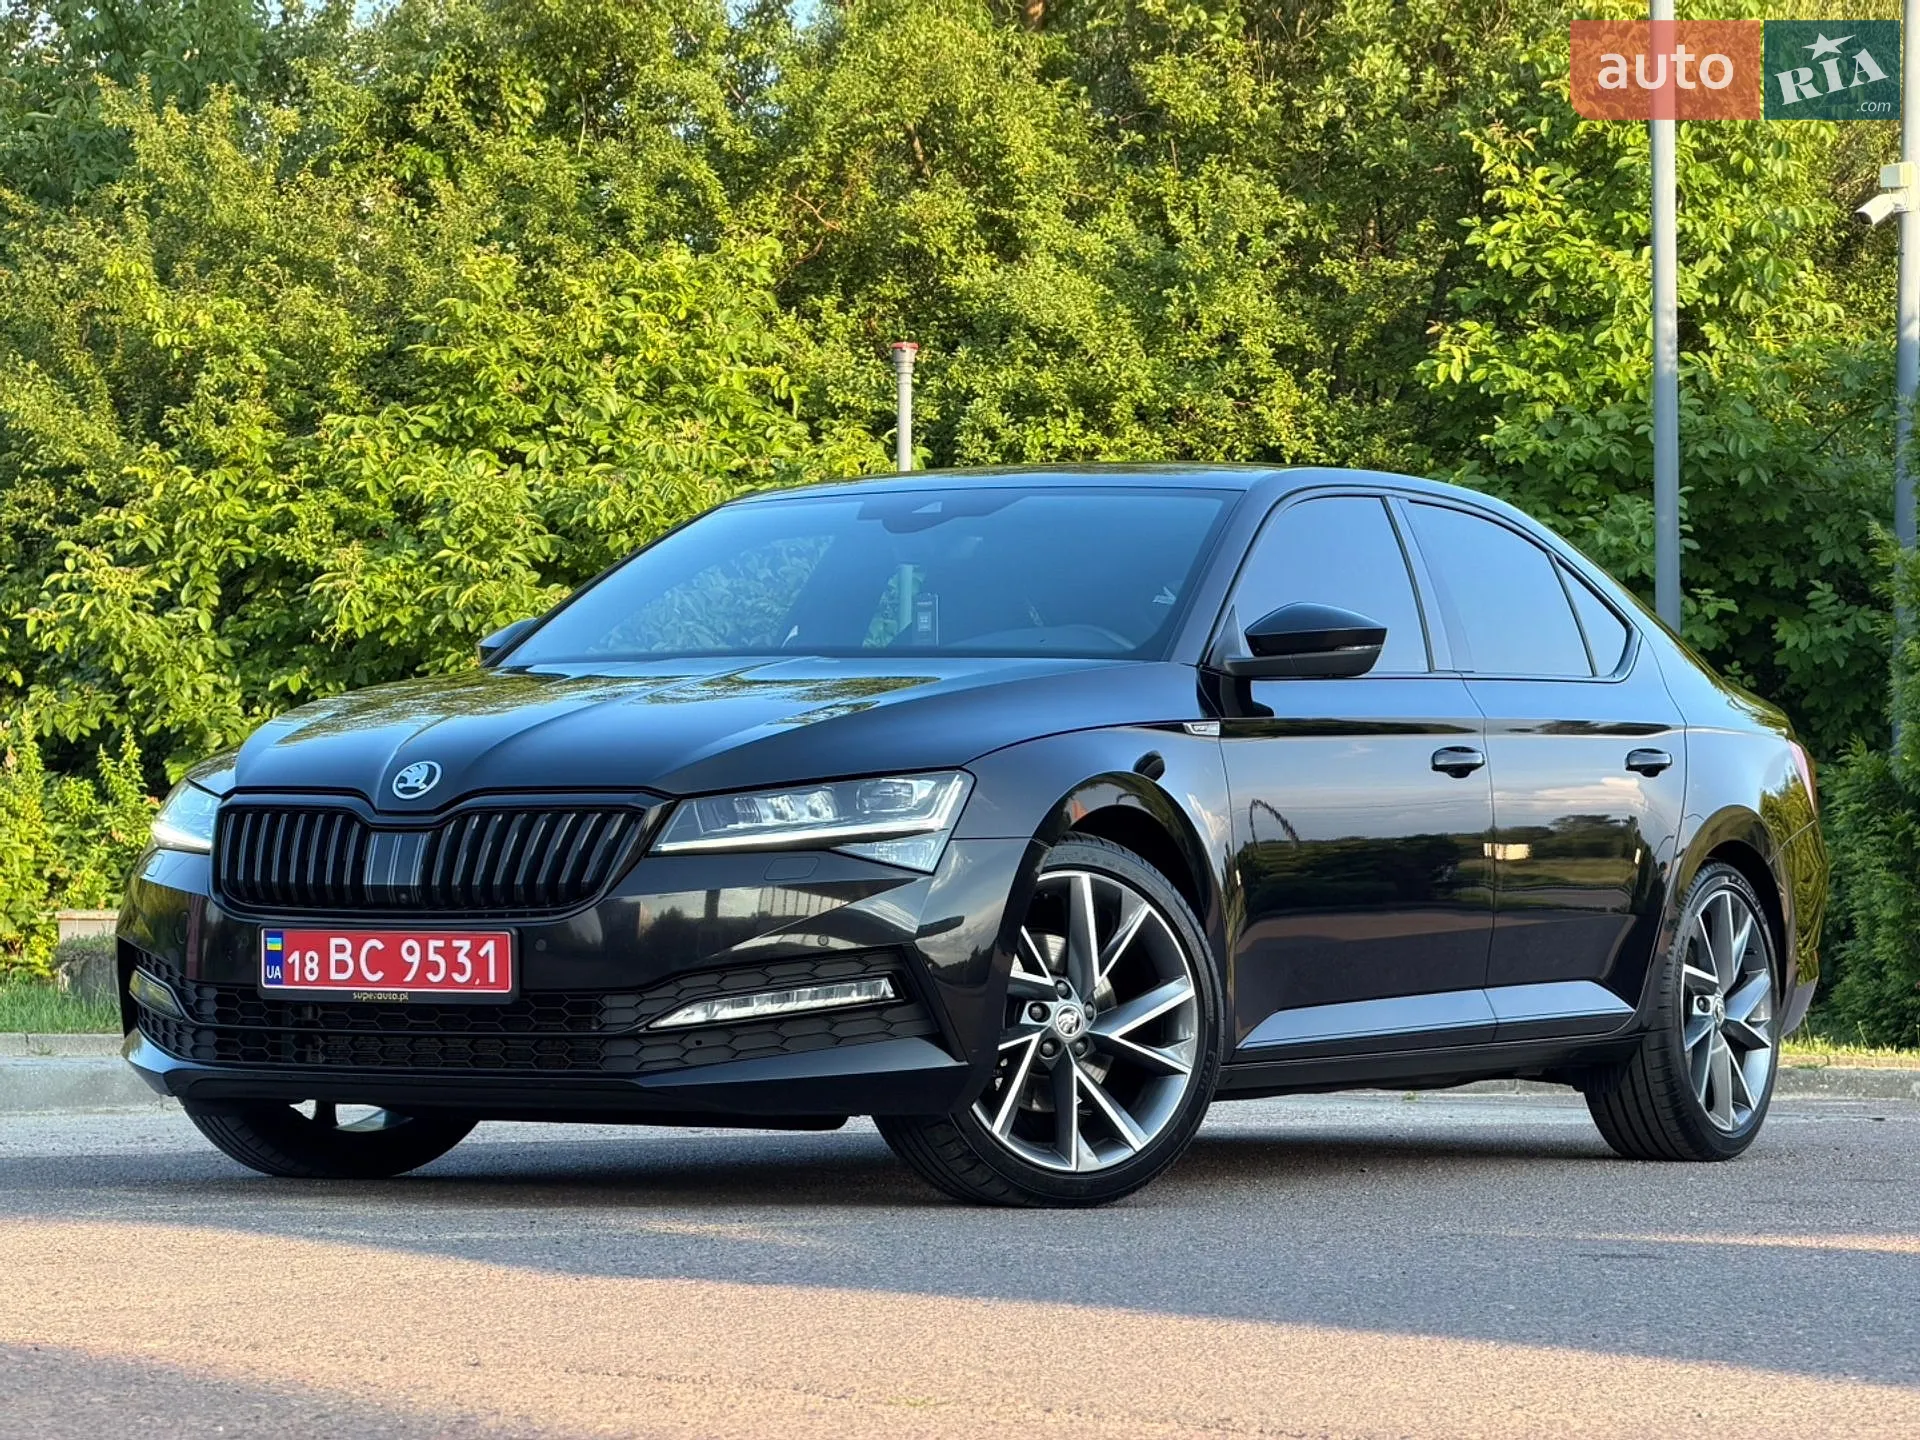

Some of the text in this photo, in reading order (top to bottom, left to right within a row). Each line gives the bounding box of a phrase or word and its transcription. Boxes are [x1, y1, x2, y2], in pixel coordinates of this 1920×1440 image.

[266, 965, 282, 980] UA
[287, 937, 497, 984] 18 BC 9531
